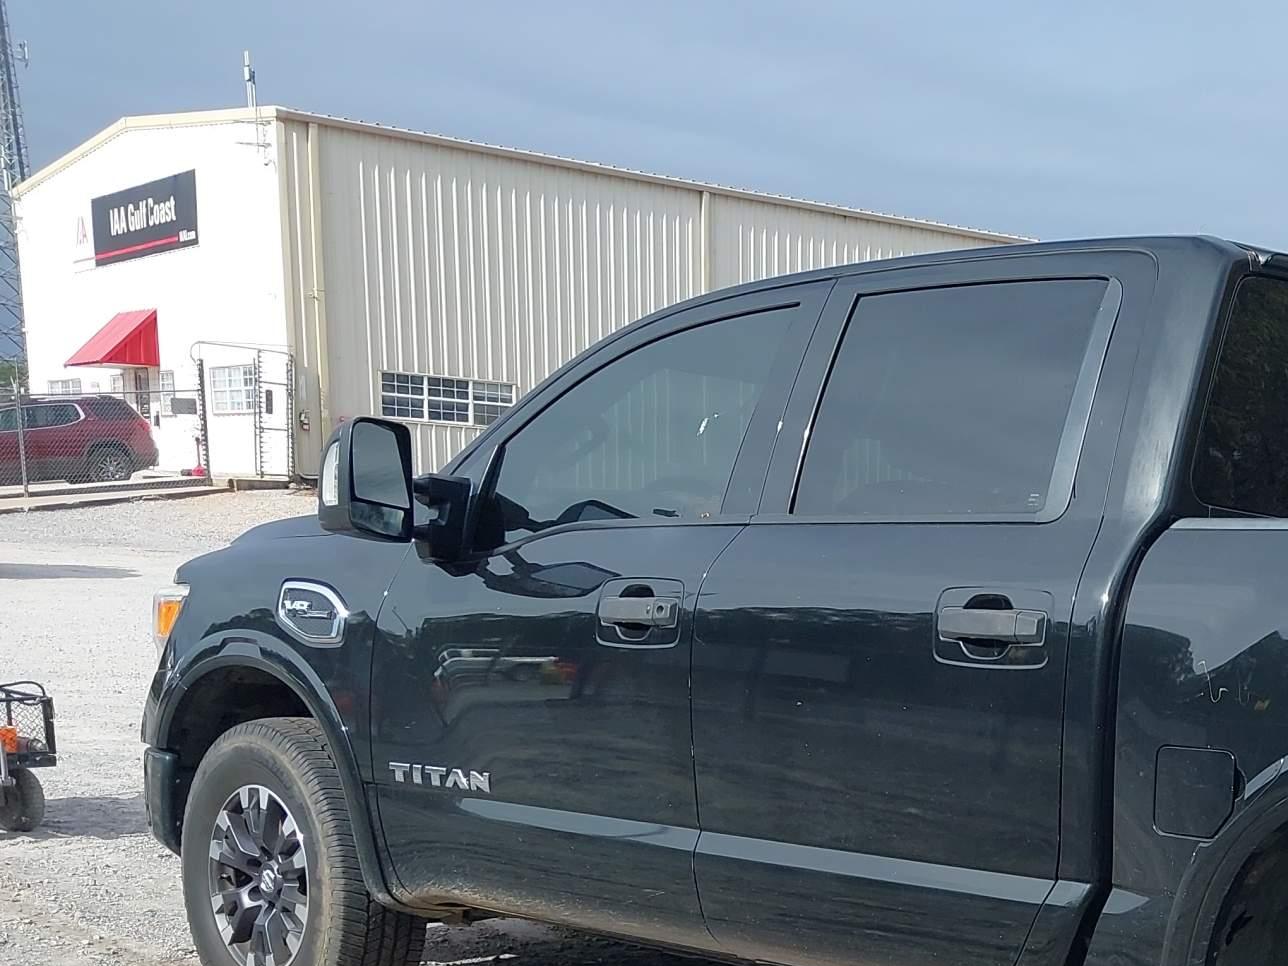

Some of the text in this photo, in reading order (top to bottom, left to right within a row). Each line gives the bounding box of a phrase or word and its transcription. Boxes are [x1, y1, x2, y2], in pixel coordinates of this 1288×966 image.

[109, 206, 127, 236] IAA
[127, 200, 147, 232] Gulf
[147, 195, 176, 227] Coast
[388, 762, 492, 793] TITAN
